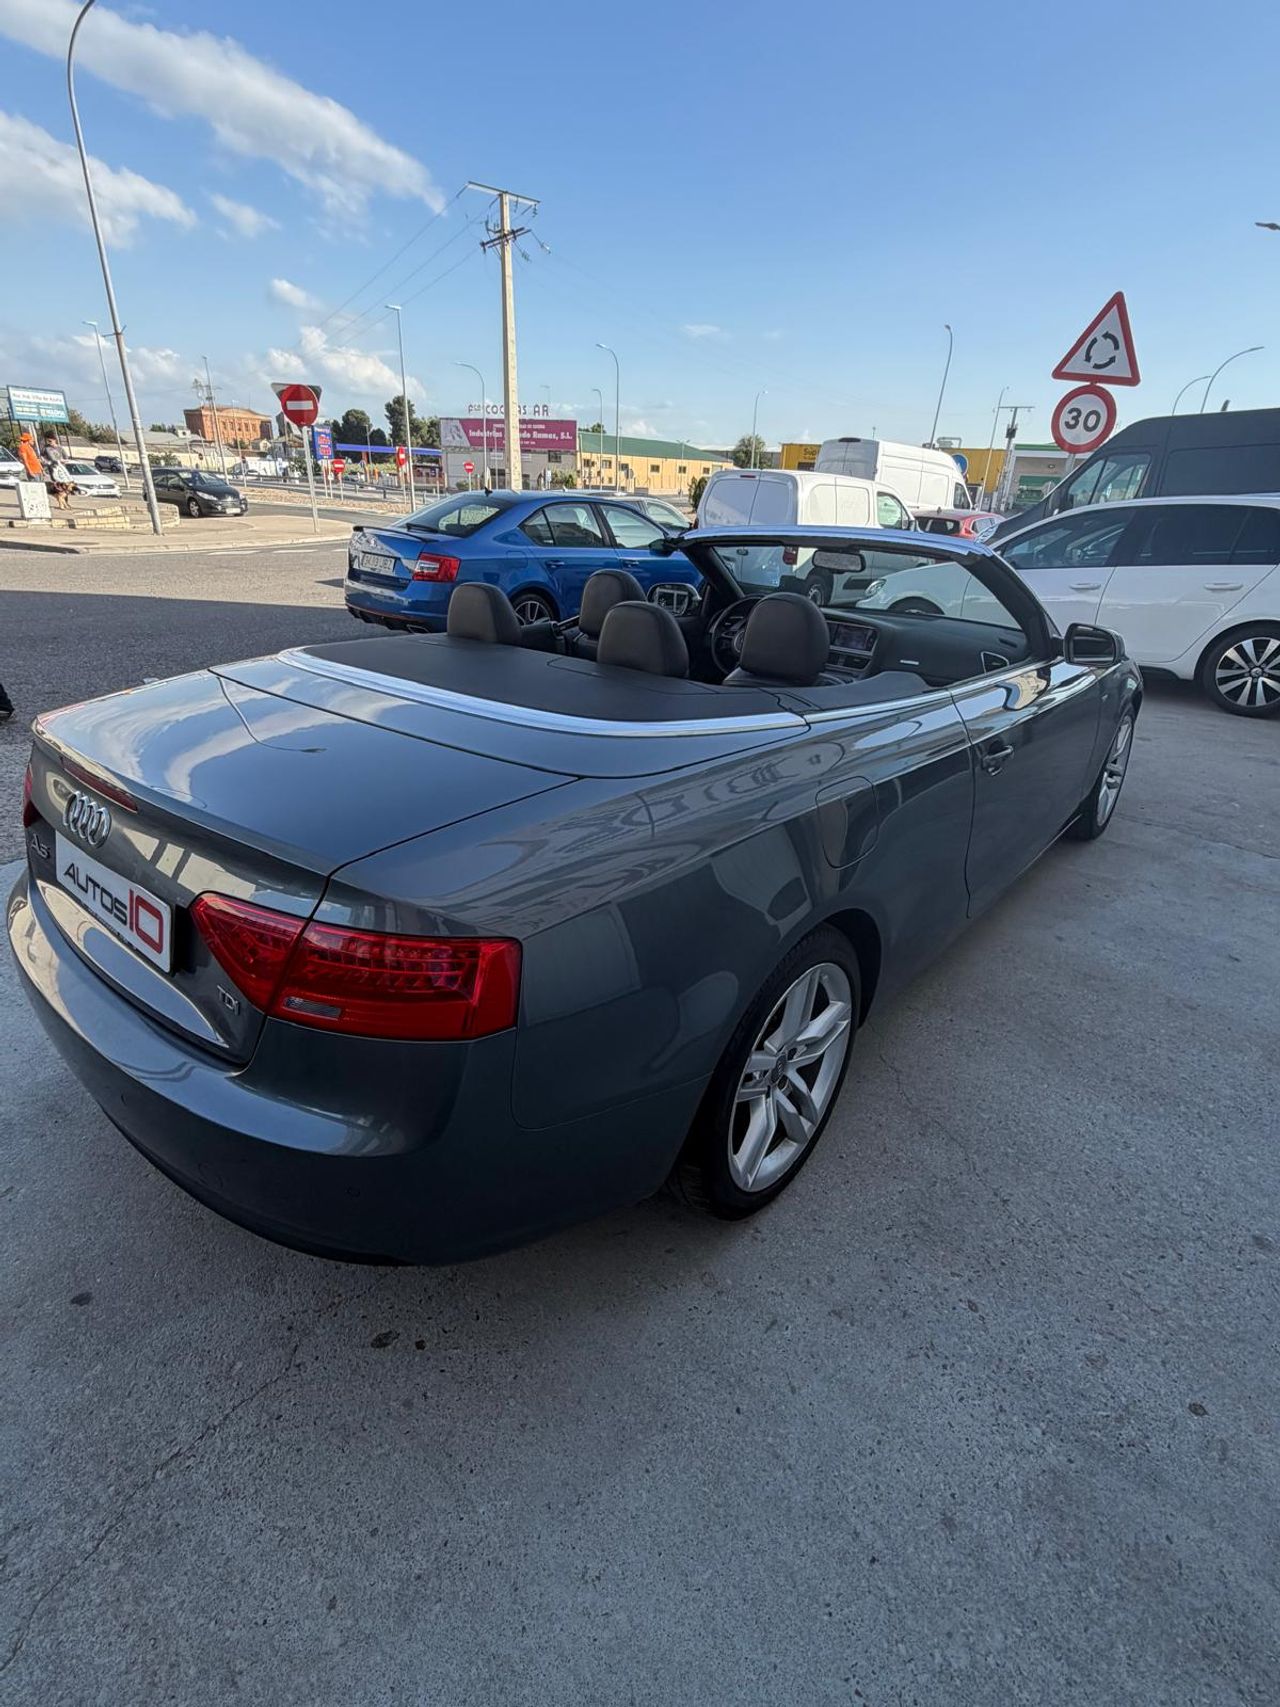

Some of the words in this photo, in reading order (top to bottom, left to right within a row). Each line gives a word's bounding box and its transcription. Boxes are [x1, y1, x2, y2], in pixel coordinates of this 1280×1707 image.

[485, 404, 527, 415] COCAS
[533, 404, 550, 416] AR
[1064, 407, 1101, 432] 30
[469, 429, 503, 438] Indutrias
[32, 833, 49, 859] A5
